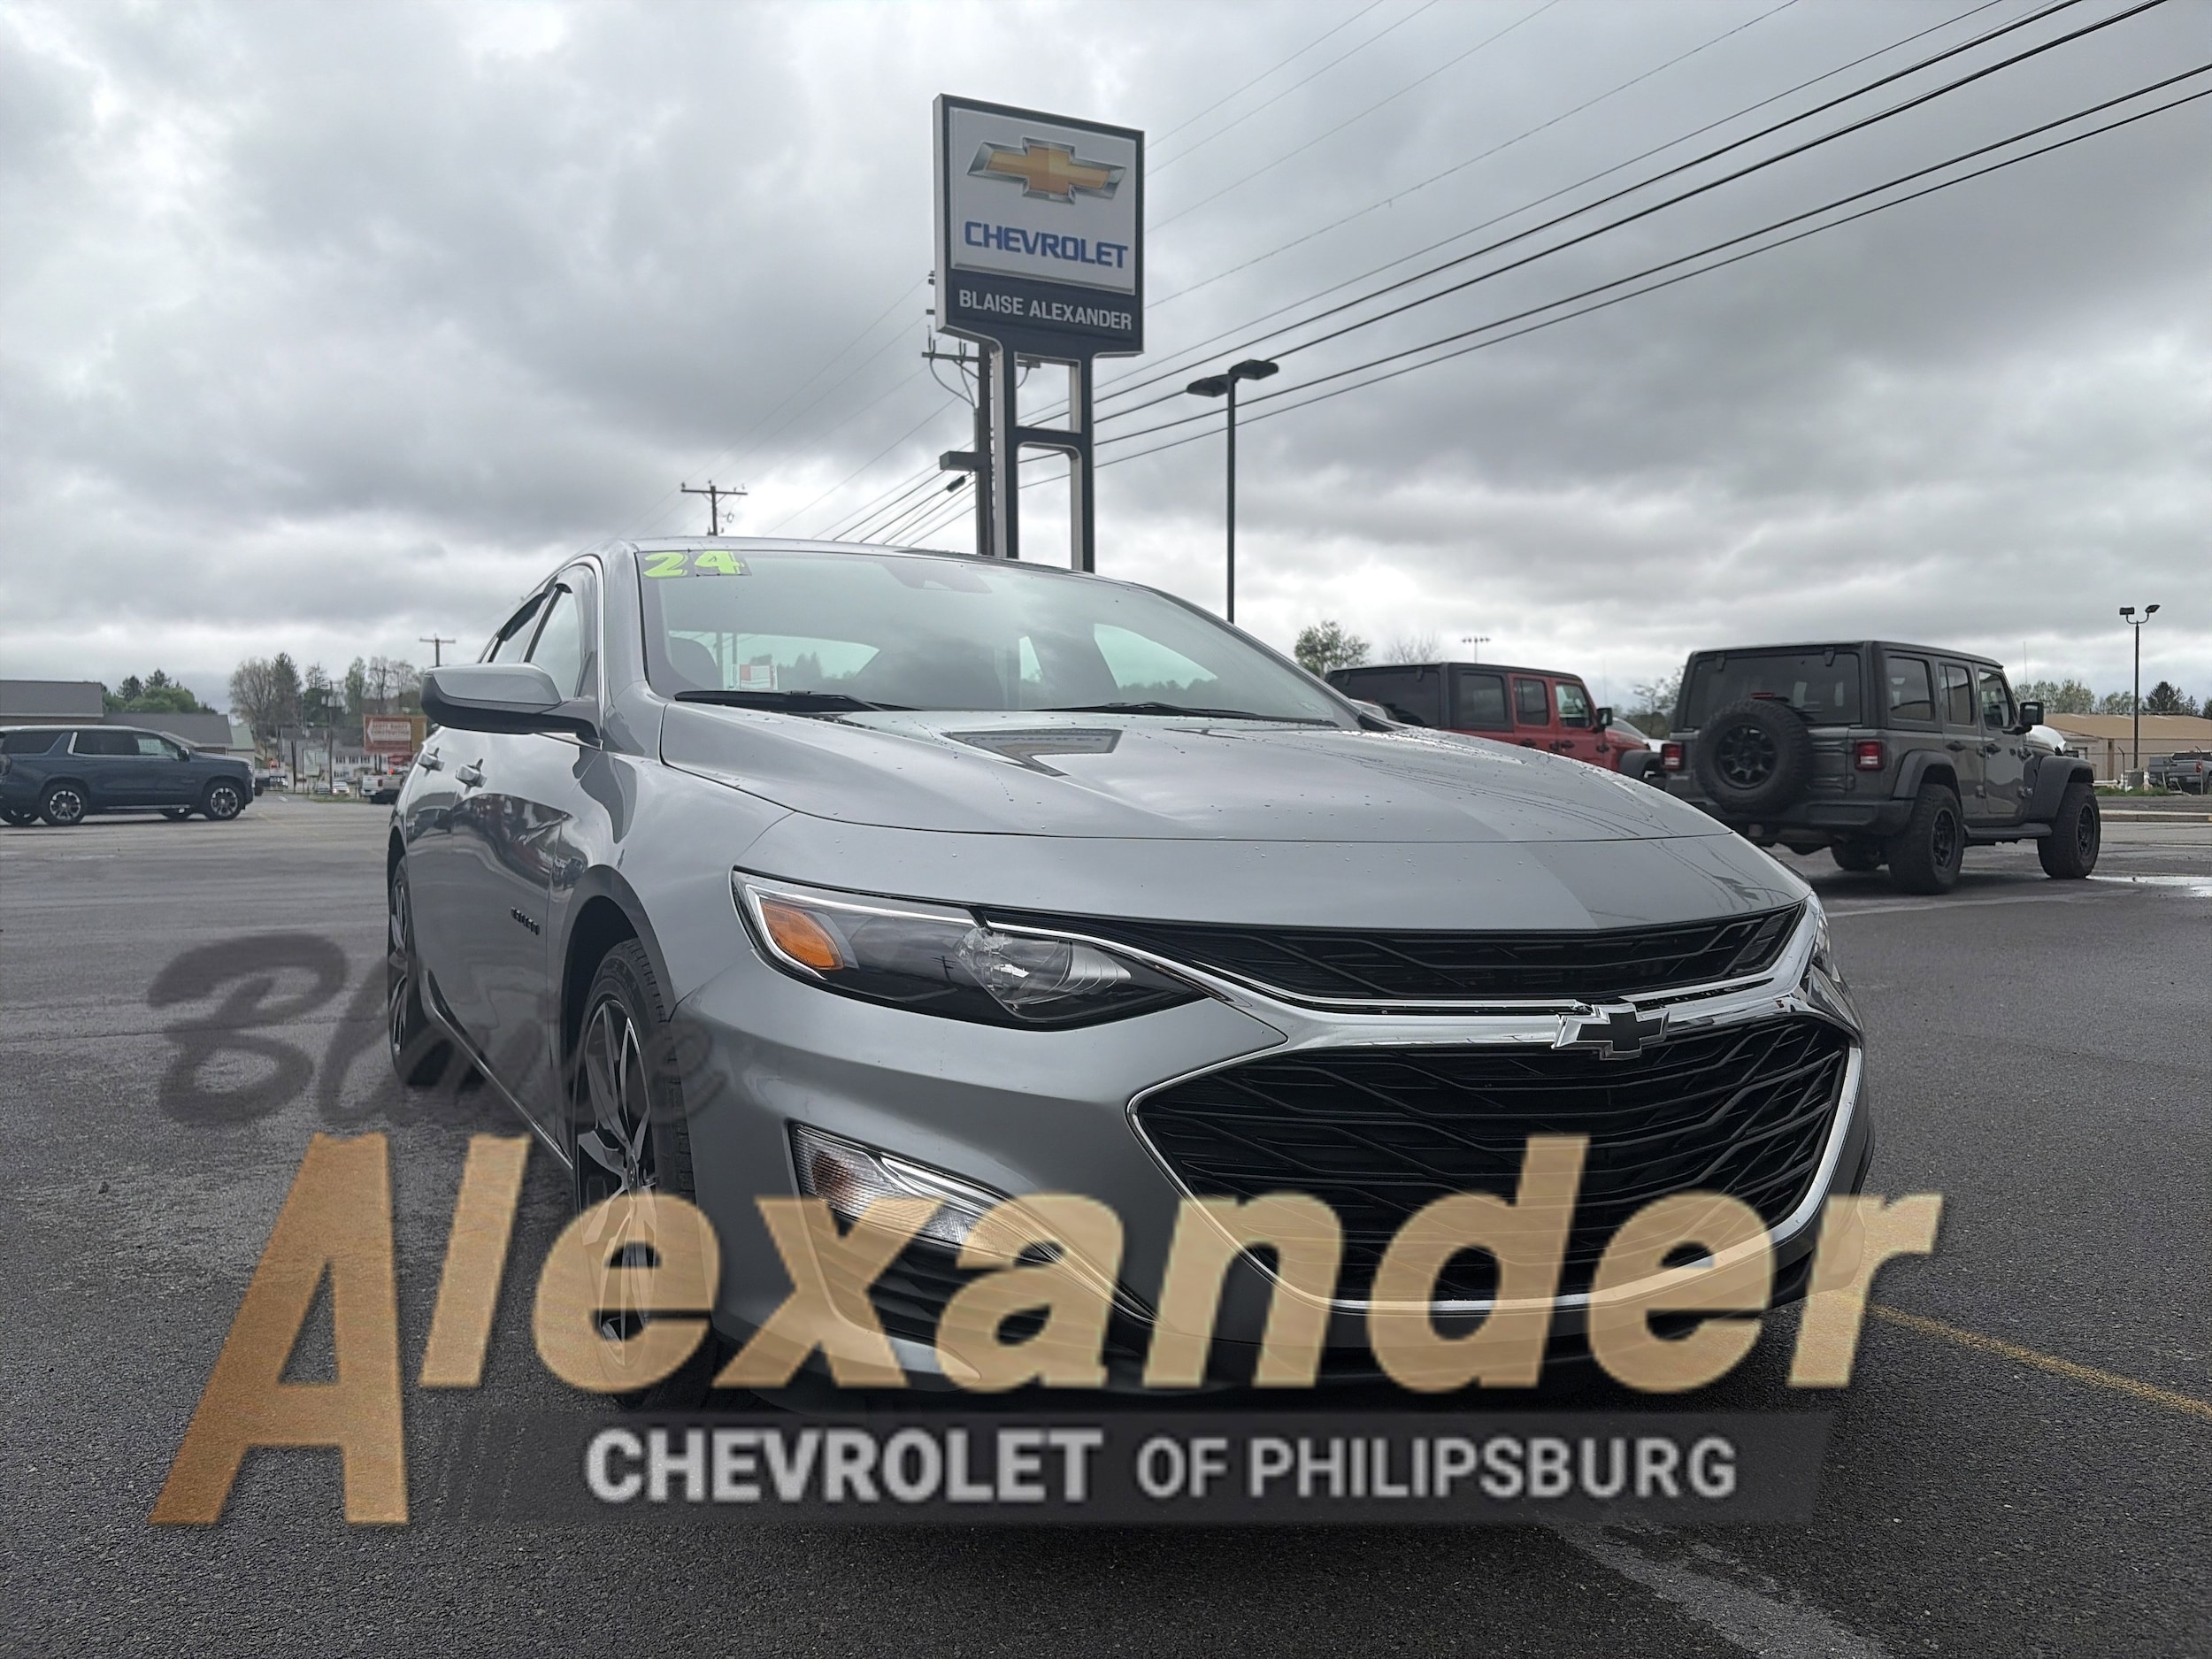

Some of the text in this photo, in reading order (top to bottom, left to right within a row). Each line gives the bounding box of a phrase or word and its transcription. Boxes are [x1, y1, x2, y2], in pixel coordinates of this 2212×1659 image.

[964, 221, 1128, 268] CHEVROLET
[959, 289, 1132, 330] BLAISE ALEXANDER
[643, 550, 745, 578] 24
